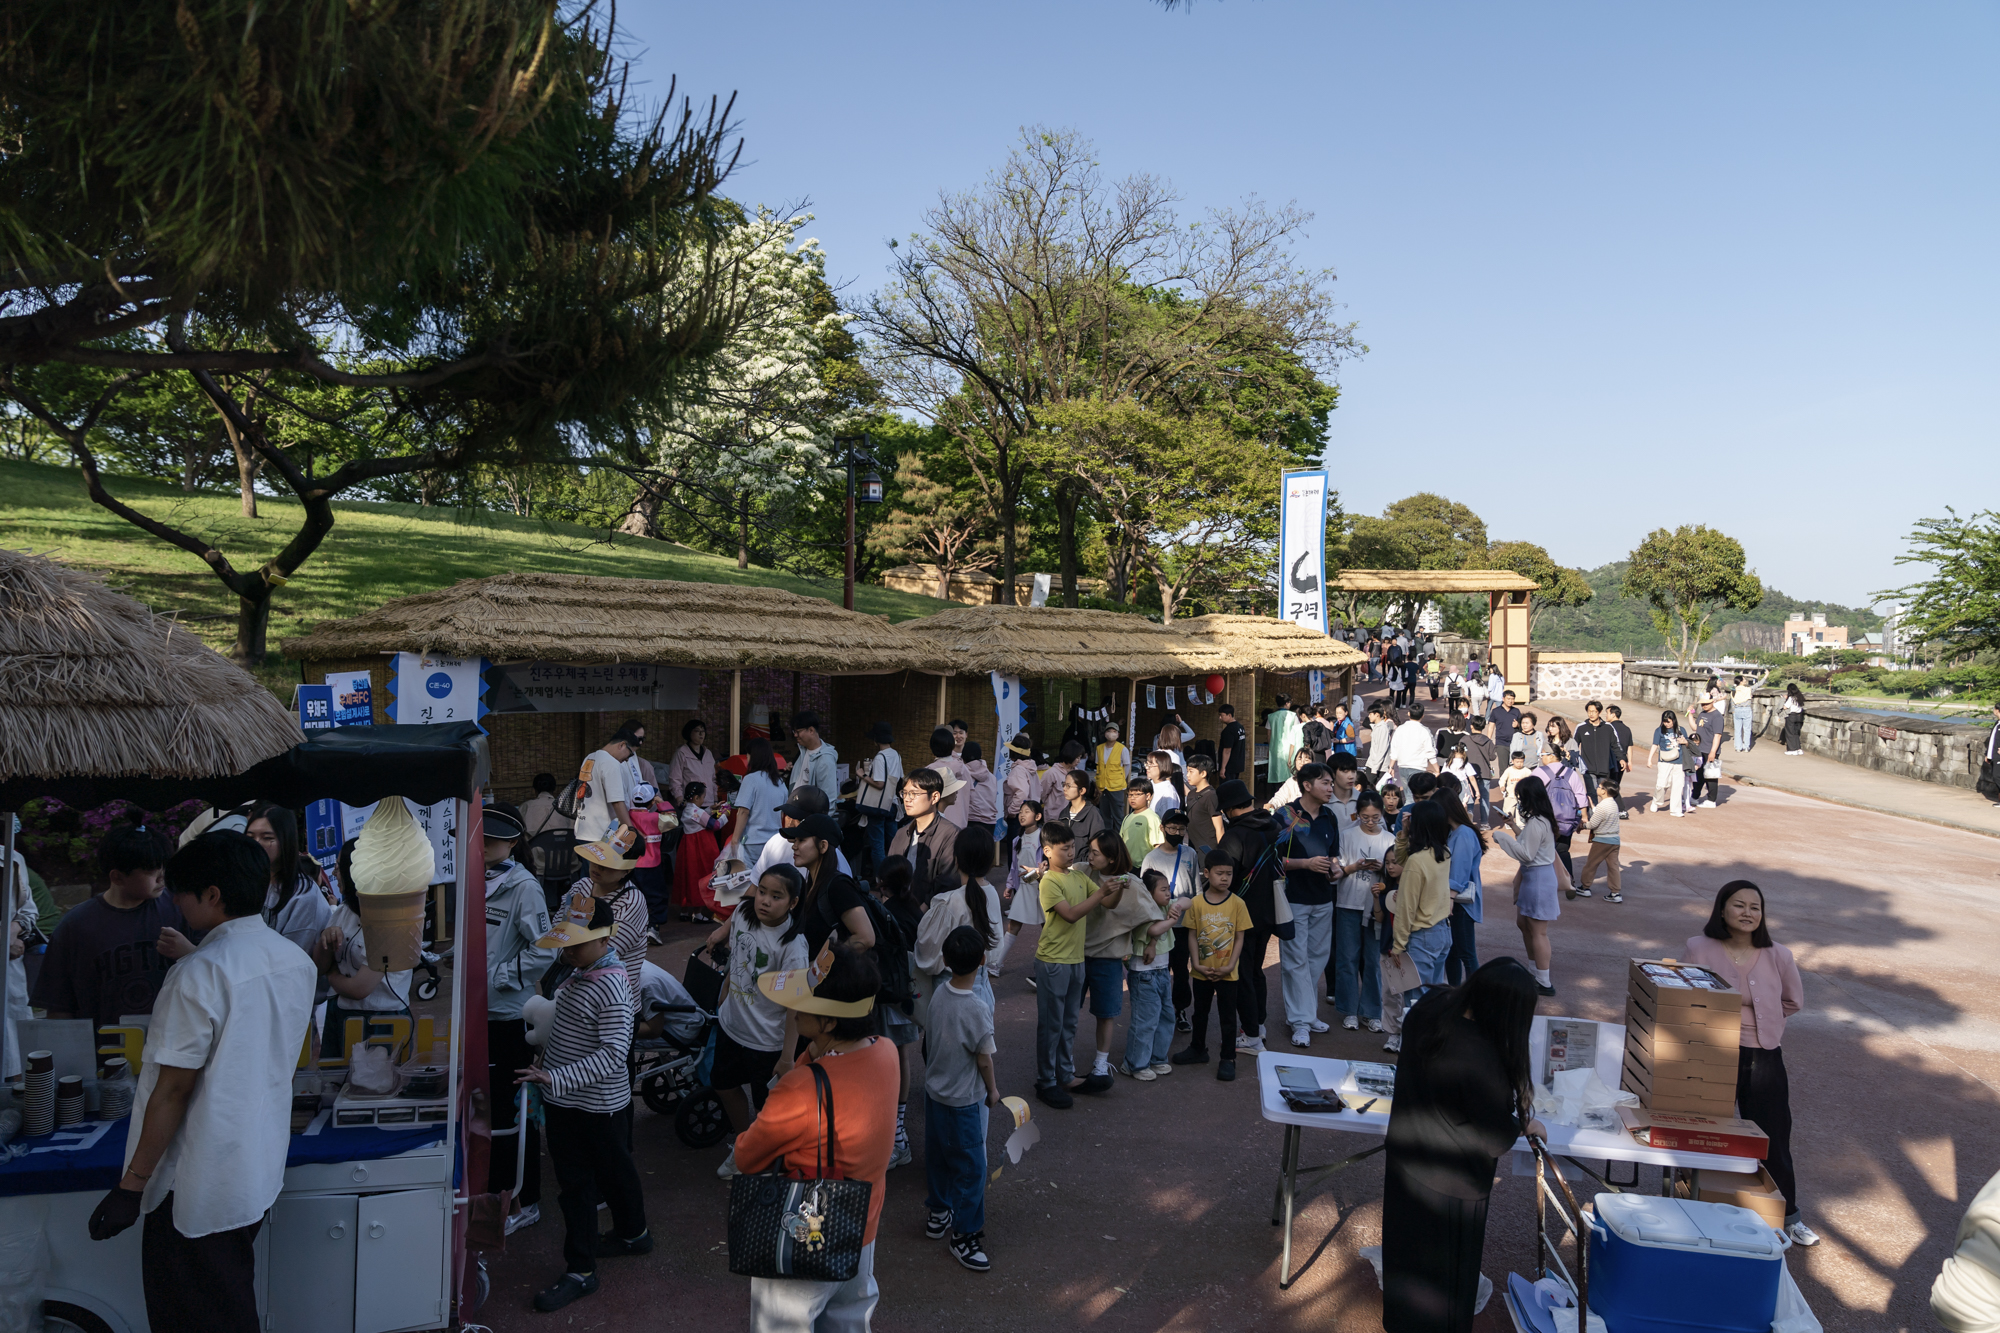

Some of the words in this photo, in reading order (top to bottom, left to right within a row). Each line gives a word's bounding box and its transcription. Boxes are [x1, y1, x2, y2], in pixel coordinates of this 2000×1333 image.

[1290, 602, 1318, 620] 구역
[530, 667, 588, 682] 진주우체국
[592, 668, 614, 681] 느린
[617, 667, 649, 682] 우체통
[577, 684, 639, 697] 크리스마스전에
[339, 691, 369, 706] 우체국FC
[307, 699, 328, 718] 우체국
